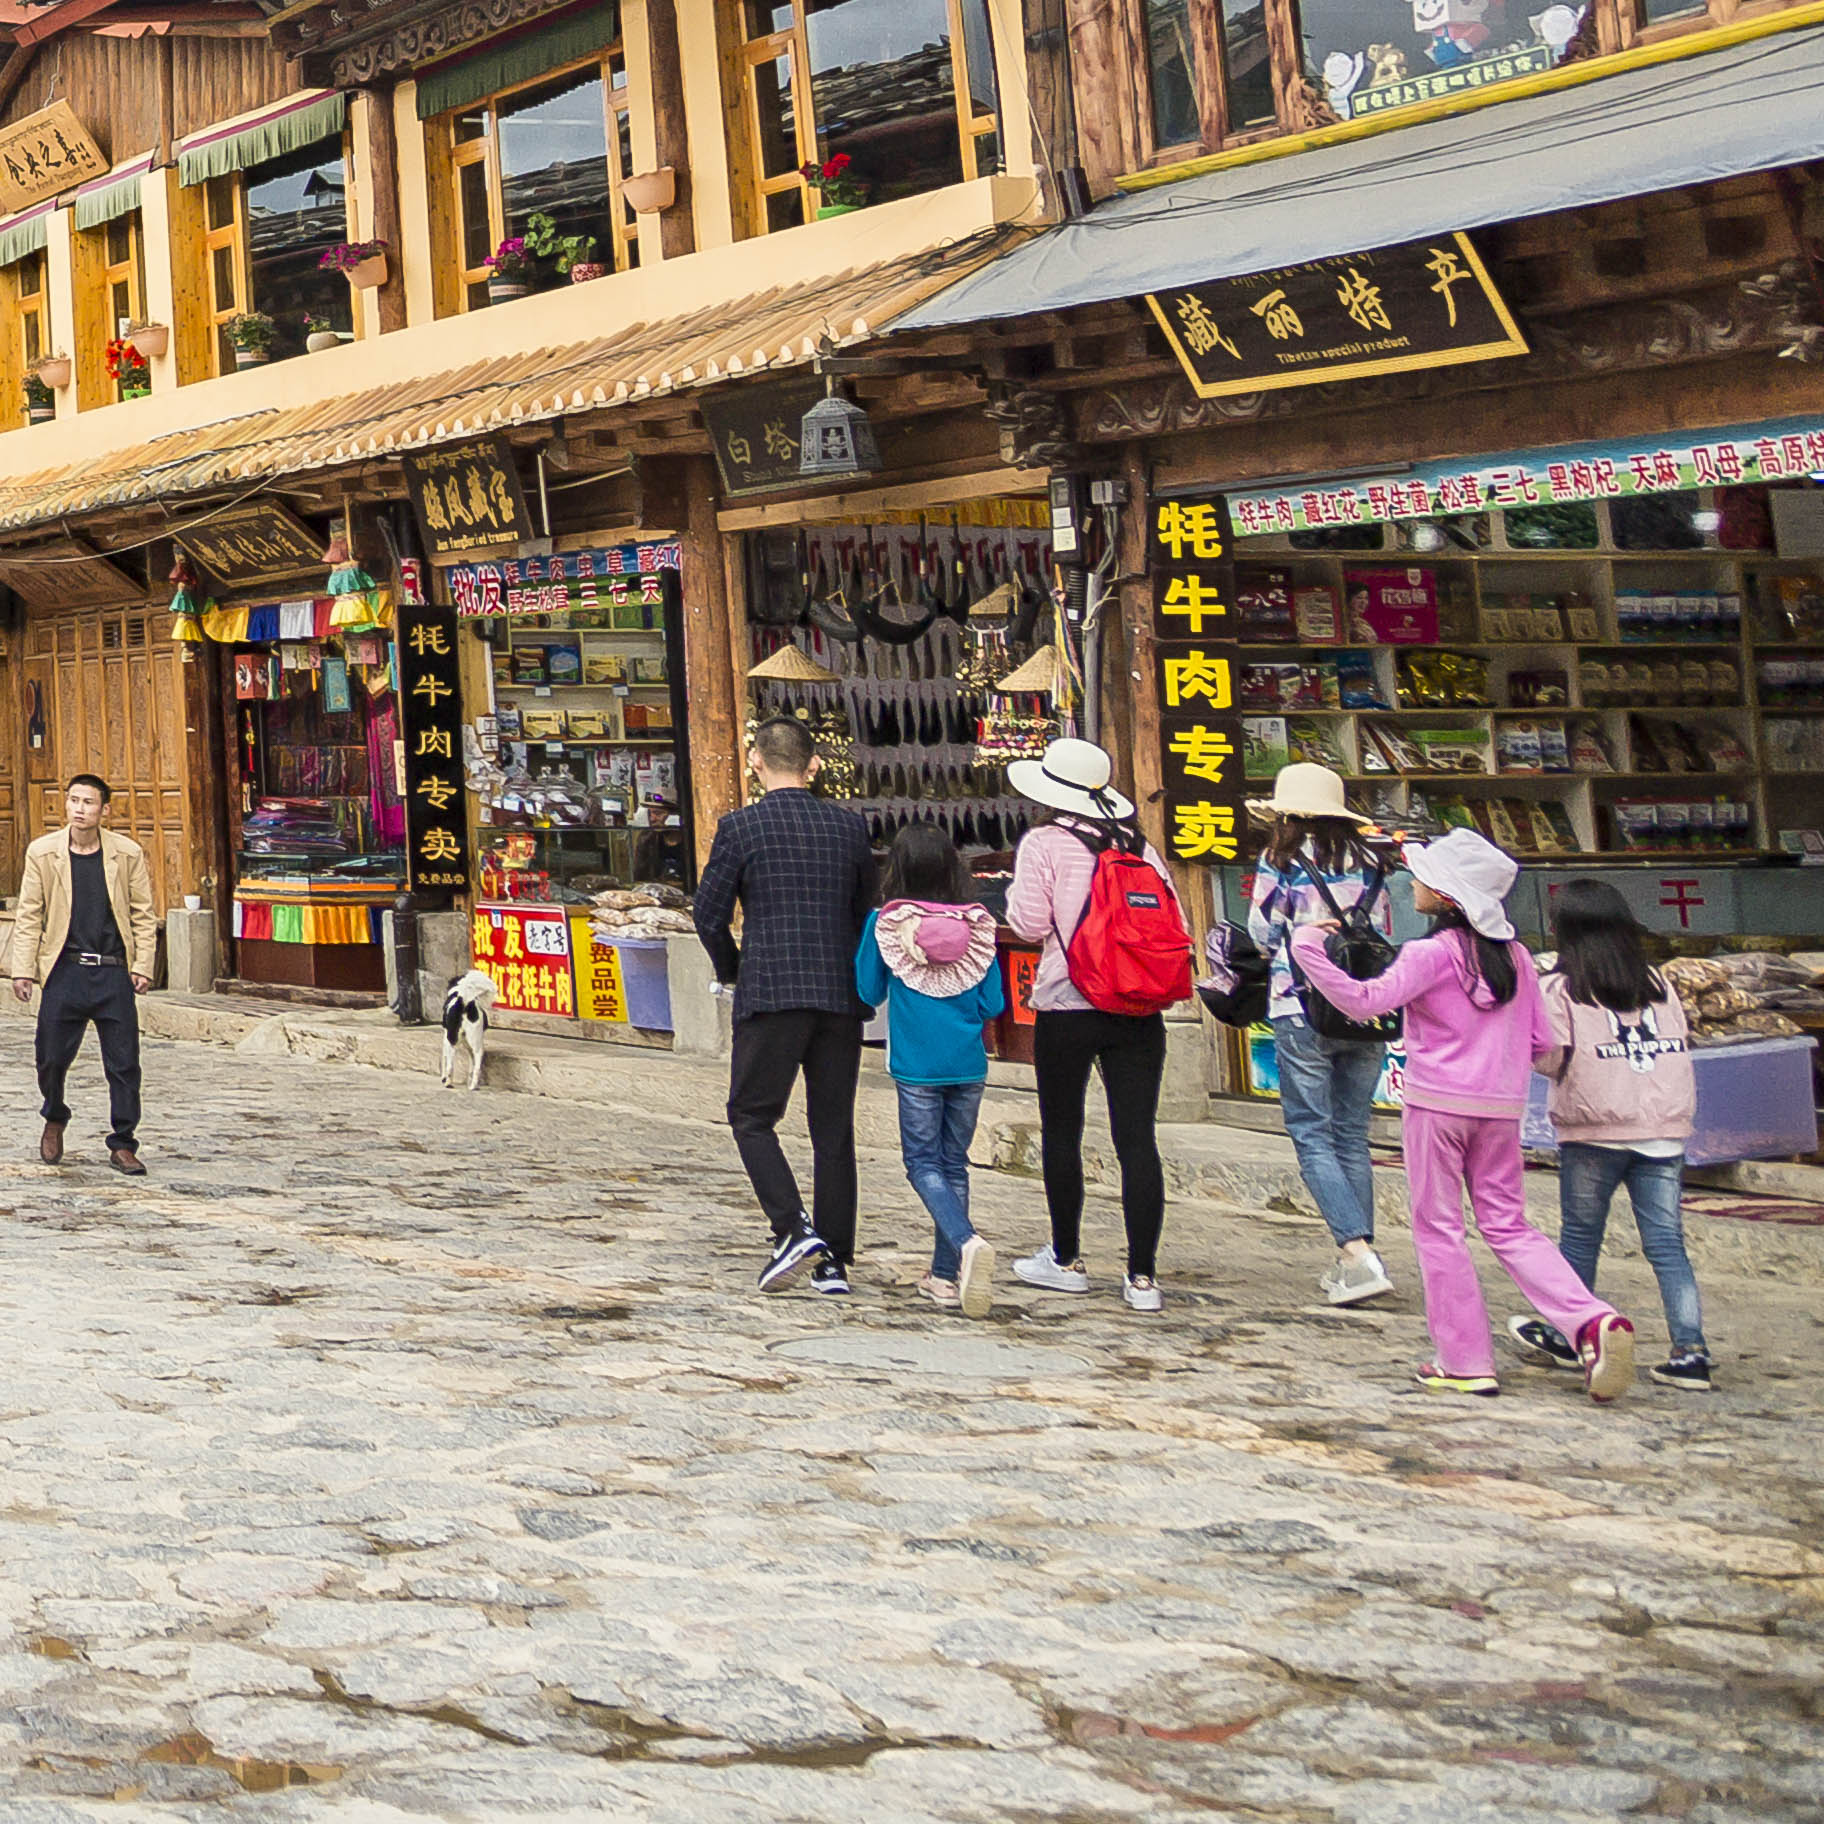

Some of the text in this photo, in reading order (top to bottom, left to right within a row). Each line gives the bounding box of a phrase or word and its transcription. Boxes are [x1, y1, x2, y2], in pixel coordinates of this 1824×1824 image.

[1176, 248, 1471, 360] 藏丽特产
[1274, 335, 1411, 365] Tibetan special product
[1238, 498, 1293, 533] 牦牛肉
[1301, 489, 1361, 526] 藏红花
[1368, 482, 1430, 519] 野生菌
[1439, 475, 1483, 512] 松茸
[1493, 469, 1537, 505] 三七
[1549, 459, 1615, 500] 黑枸杞
[1630, 450, 1679, 492] 天麻
[1694, 443, 1741, 484] 贝母
[577, 548, 625, 580] 虫草
[636, 543, 682, 573] 藏红
[453, 565, 506, 617] 批发
[507, 583, 570, 614] 野生松茸
[579, 579, 628, 609] 三七
[1158, 502, 1238, 859] 牦牛肉专卖
[409, 624, 461, 861] 牦牛肉专卖
[473, 914, 523, 959] 批发
[589, 917, 618, 1018] 费品尝
[1598, 1037, 1682, 1057] THE PUPPY
